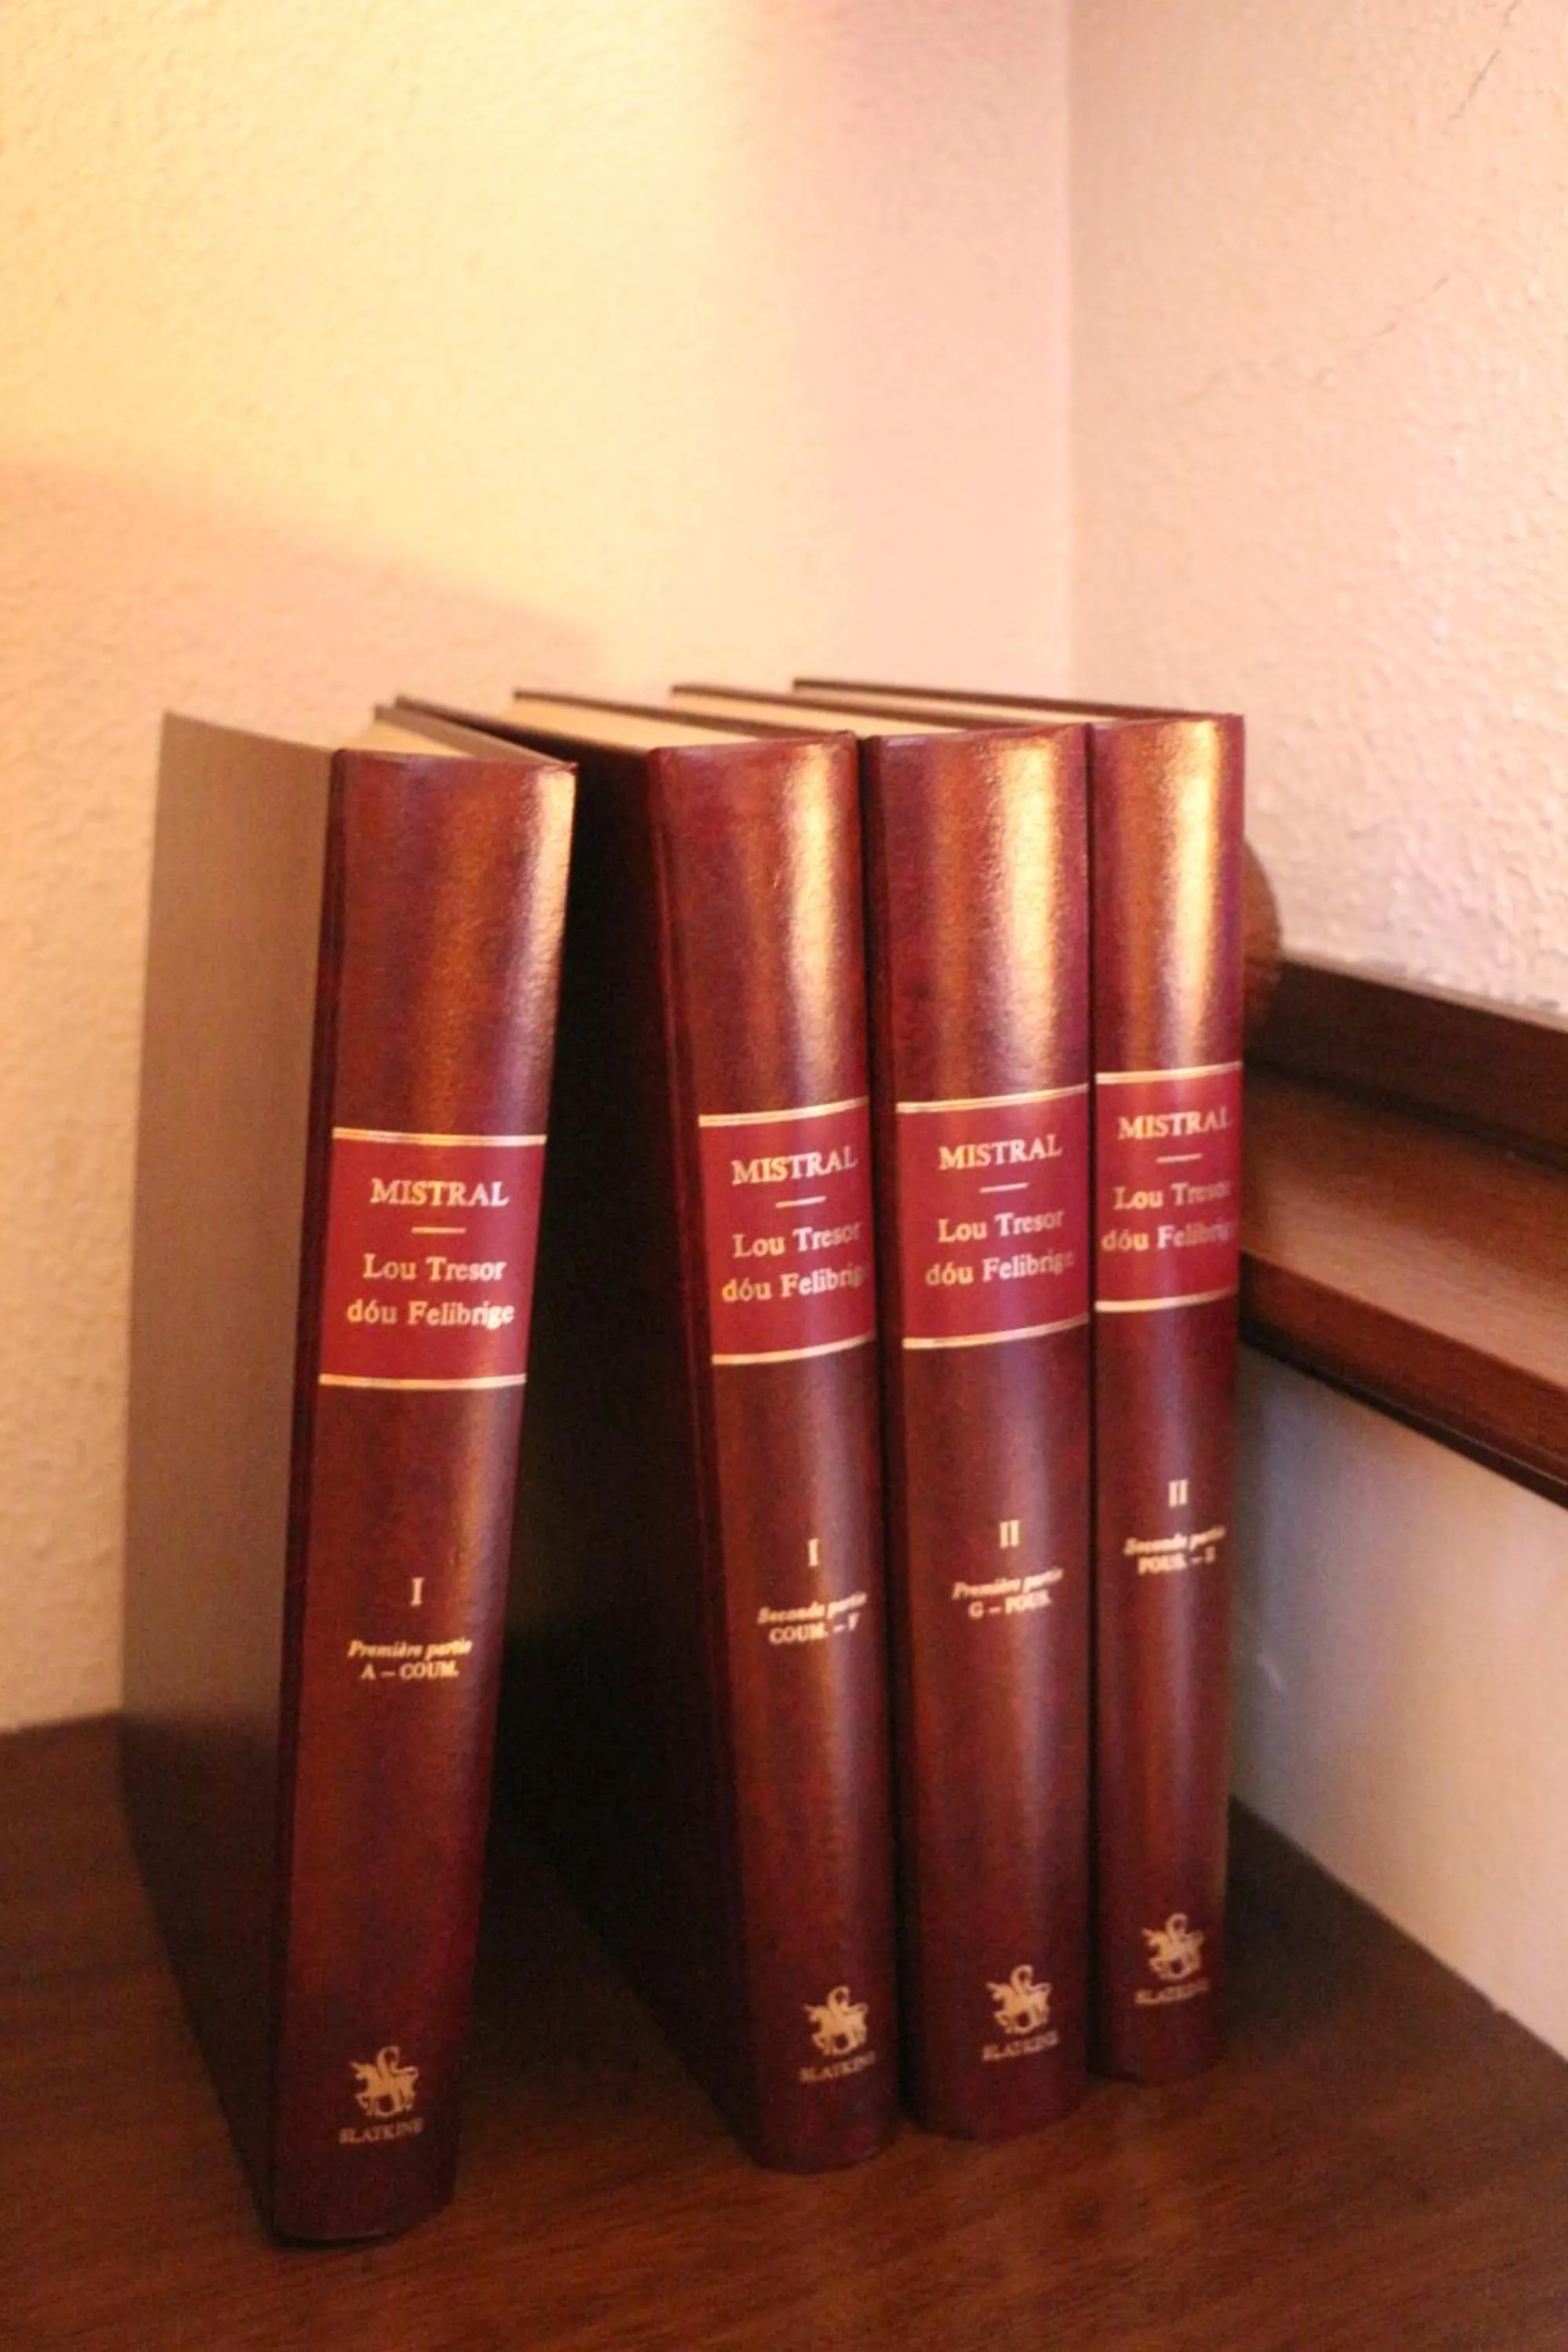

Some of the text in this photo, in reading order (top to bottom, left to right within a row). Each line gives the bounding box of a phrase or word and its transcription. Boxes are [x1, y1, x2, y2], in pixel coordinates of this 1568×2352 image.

[1117, 1106, 1230, 1140] MISTRAL
[731, 1145, 858, 1185] MISTRAL
[938, 1134, 1062, 1171] MISTRAL
[369, 1178, 510, 1207] MISTRAL
[1113, 1186, 1163, 1210] Lou
[733, 1221, 862, 1258] Lou Tresor
[938, 1210, 1064, 1243] Lou Tresor
[1102, 1229, 1149, 1252] dóu
[363, 1254, 506, 1281] Lou Tresor
[925, 1260, 974, 1286] dóu
[721, 1274, 772, 1303] dóu
[347, 1299, 515, 1330] dóu Felibrige
[1168, 1479, 1189, 1508] II
[1000, 1519, 1020, 1548] II
[808, 1539, 819, 1566] I
[410, 1577, 424, 1606] I
[361, 1663, 376, 1679] A
